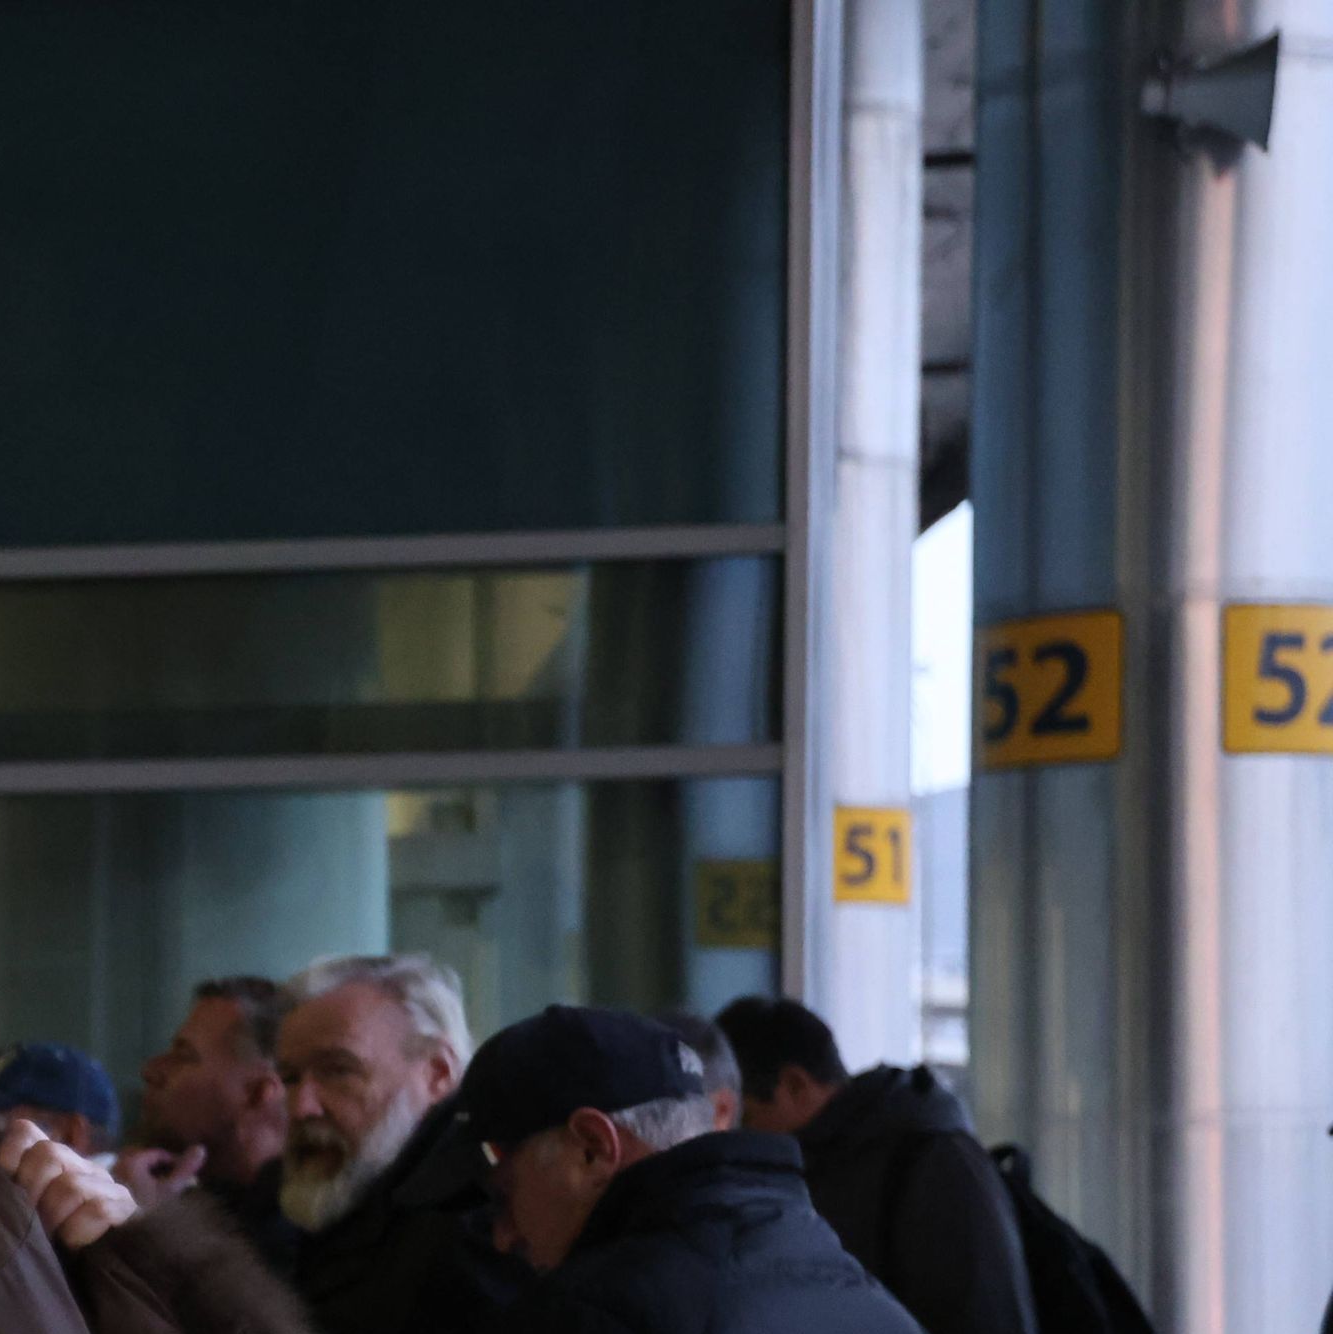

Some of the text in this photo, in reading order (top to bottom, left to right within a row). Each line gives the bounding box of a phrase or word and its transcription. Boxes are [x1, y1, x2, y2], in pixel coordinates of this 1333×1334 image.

[984, 639, 1090, 742] 52
[1252, 634, 1333, 724] 5
[843, 823, 905, 885] 51
